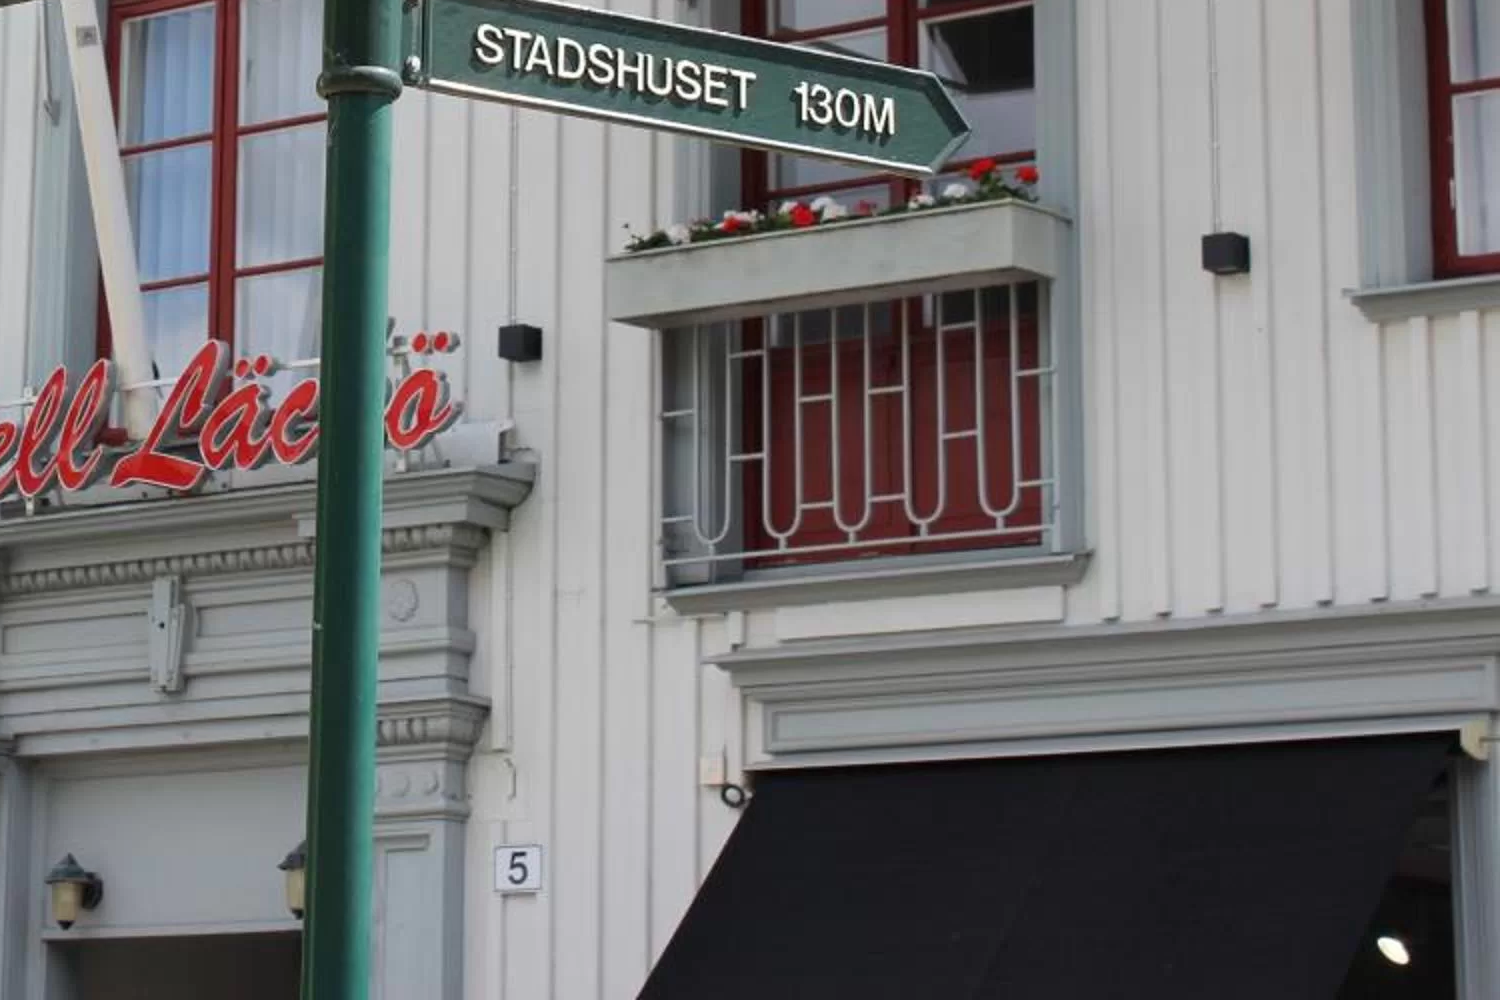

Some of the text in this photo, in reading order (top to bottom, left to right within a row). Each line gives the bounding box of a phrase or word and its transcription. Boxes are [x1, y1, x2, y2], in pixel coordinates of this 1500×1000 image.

[474, 23, 896, 135] STADSHUSET 130M
[110, 331, 453, 491] Läcö
[507, 850, 529, 885] 5
